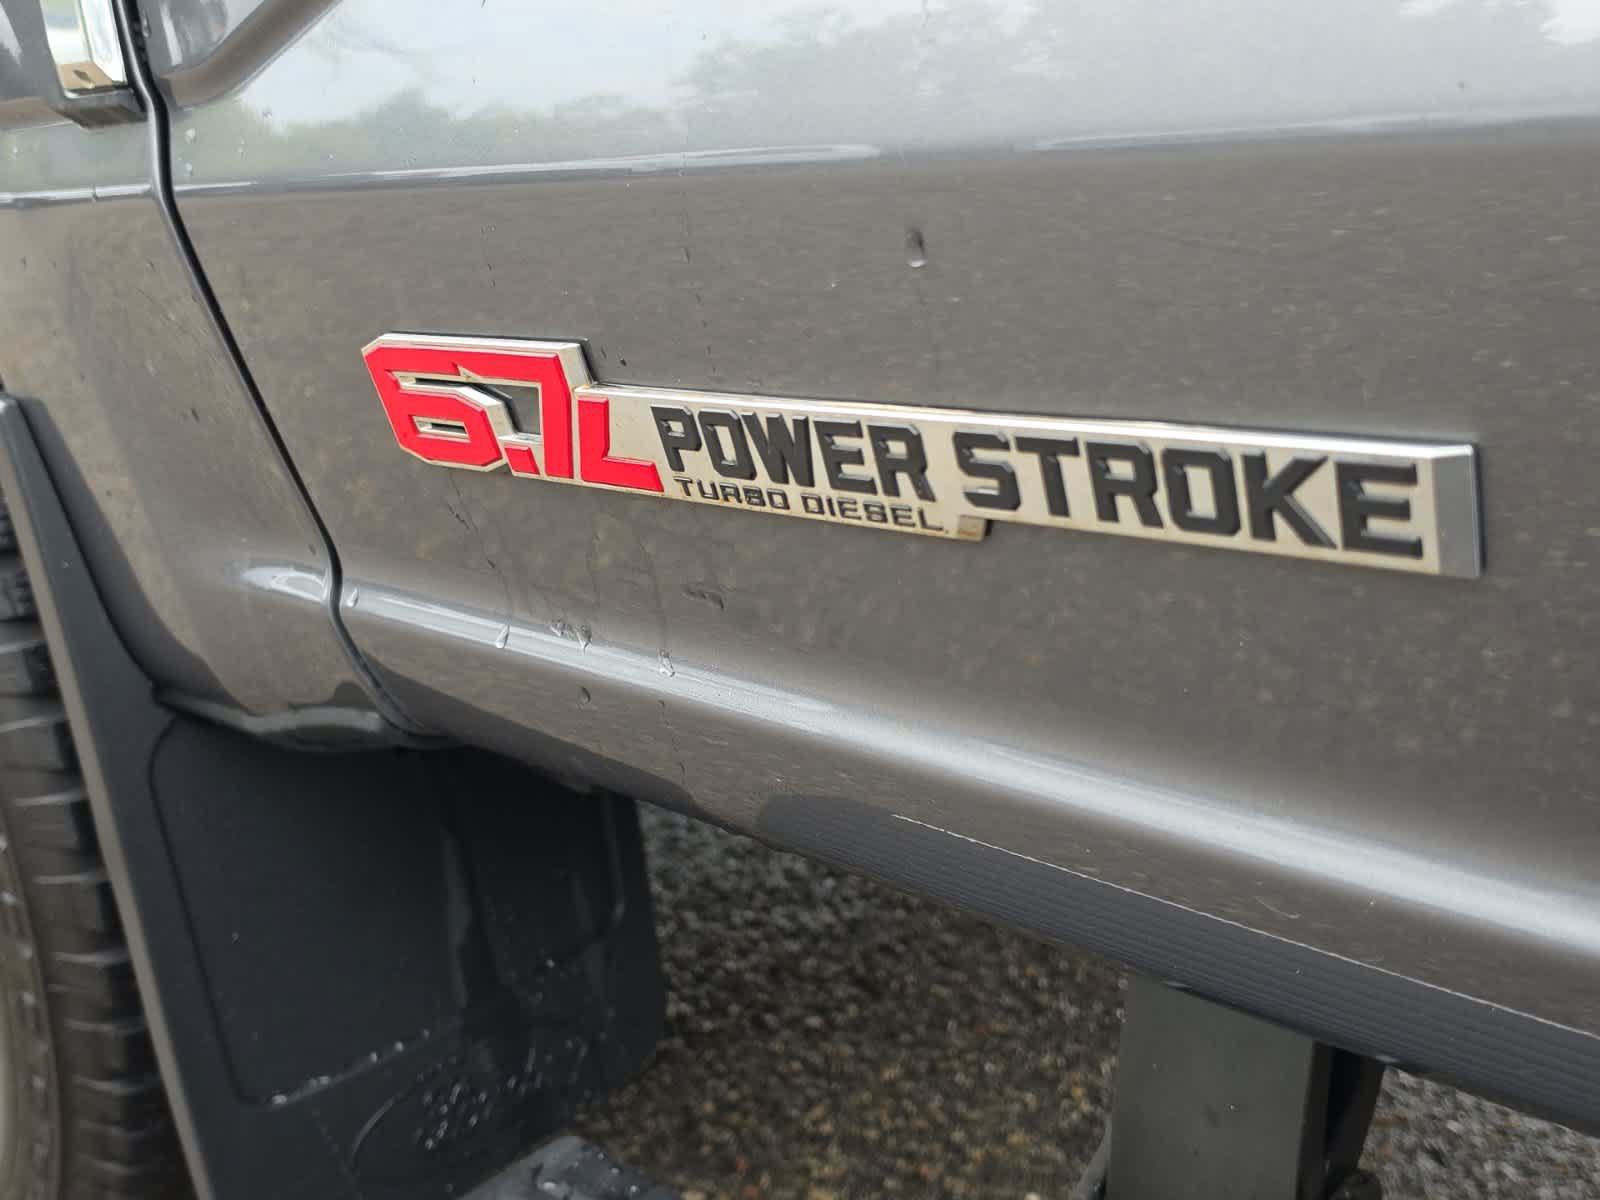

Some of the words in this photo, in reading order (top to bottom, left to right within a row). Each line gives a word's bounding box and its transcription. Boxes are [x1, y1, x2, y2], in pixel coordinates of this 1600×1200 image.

[363, 344, 665, 492] 6.7L
[650, 406, 936, 502] POWER
[952, 431, 1424, 559] STROKE
[673, 476, 790, 510] TURBO
[801, 493, 945, 532] DIESEL
